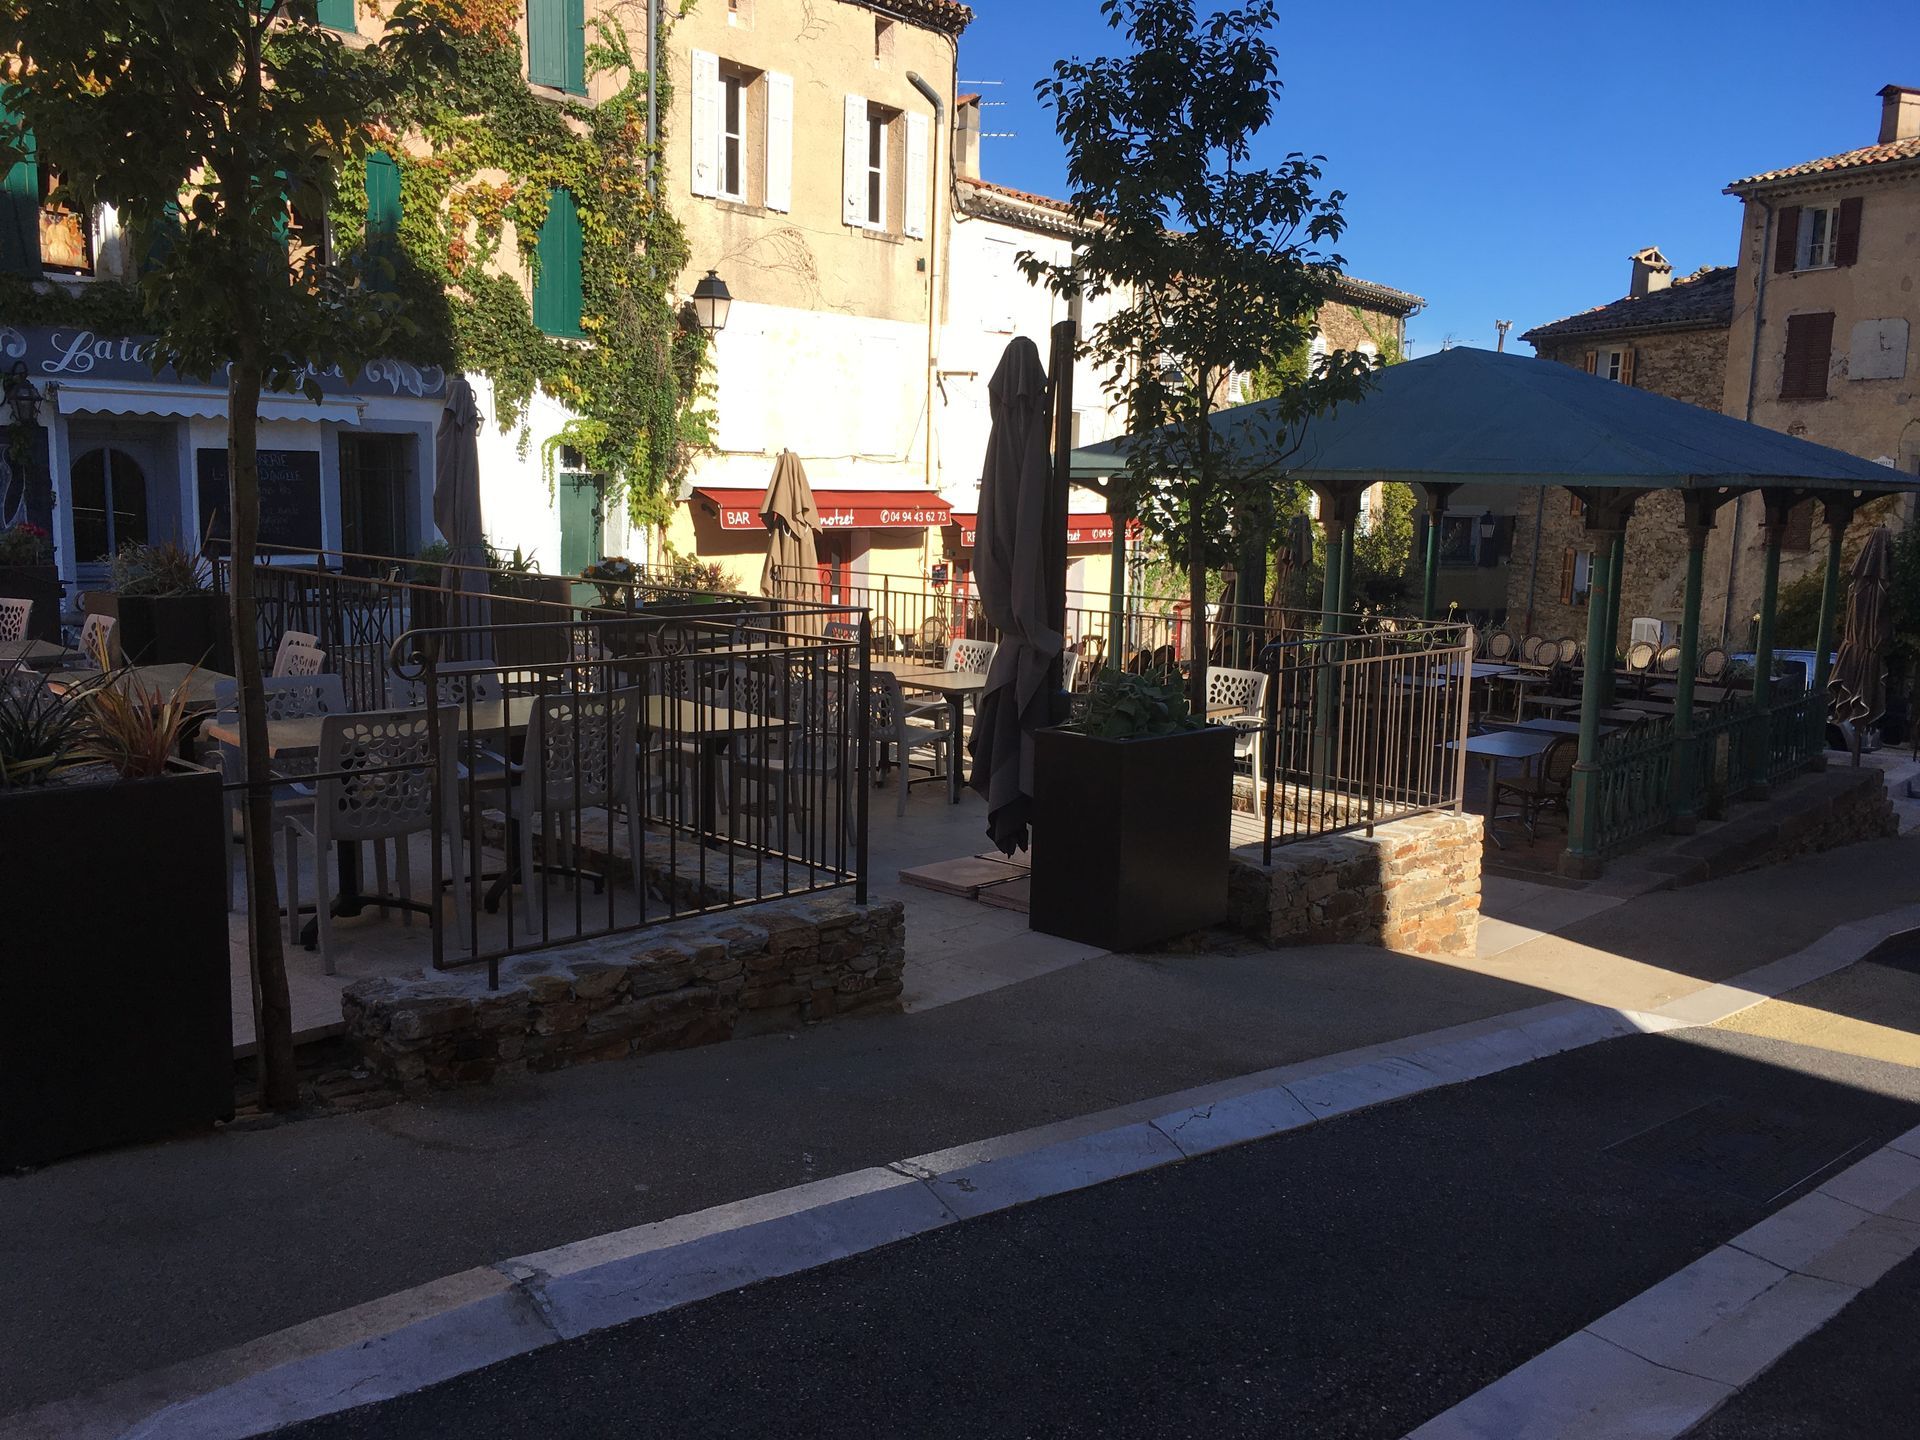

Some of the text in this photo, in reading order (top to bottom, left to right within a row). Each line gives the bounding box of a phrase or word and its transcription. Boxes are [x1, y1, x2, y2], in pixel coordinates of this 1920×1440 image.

[727, 511, 751, 525] BAR
[820, 508, 947, 526] notzet 04 94 43 62 73
